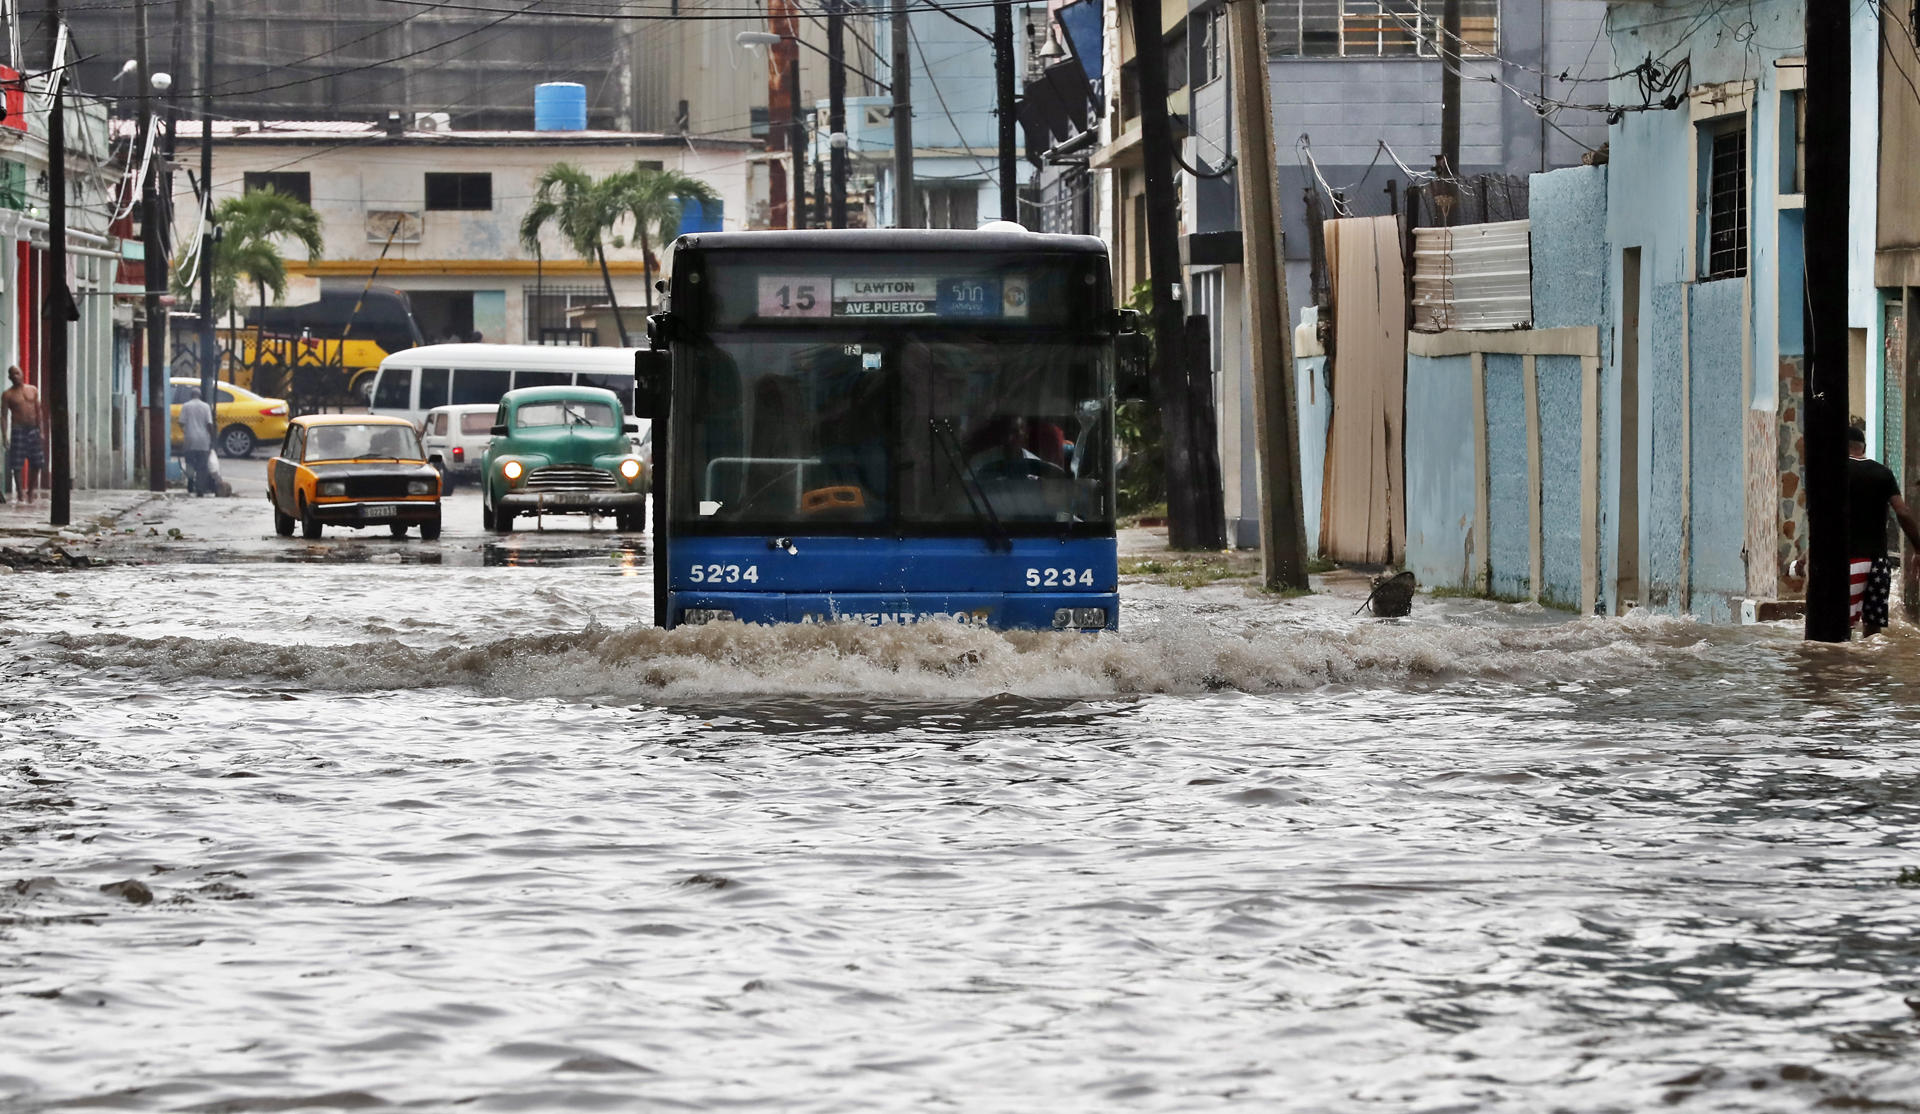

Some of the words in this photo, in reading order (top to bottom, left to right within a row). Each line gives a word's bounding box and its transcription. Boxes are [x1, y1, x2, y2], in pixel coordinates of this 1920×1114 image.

[854, 282, 915, 294] LAWTON
[776, 284, 816, 311] 15
[689, 564, 759, 583] 5234
[1026, 568, 1094, 586] 5234
